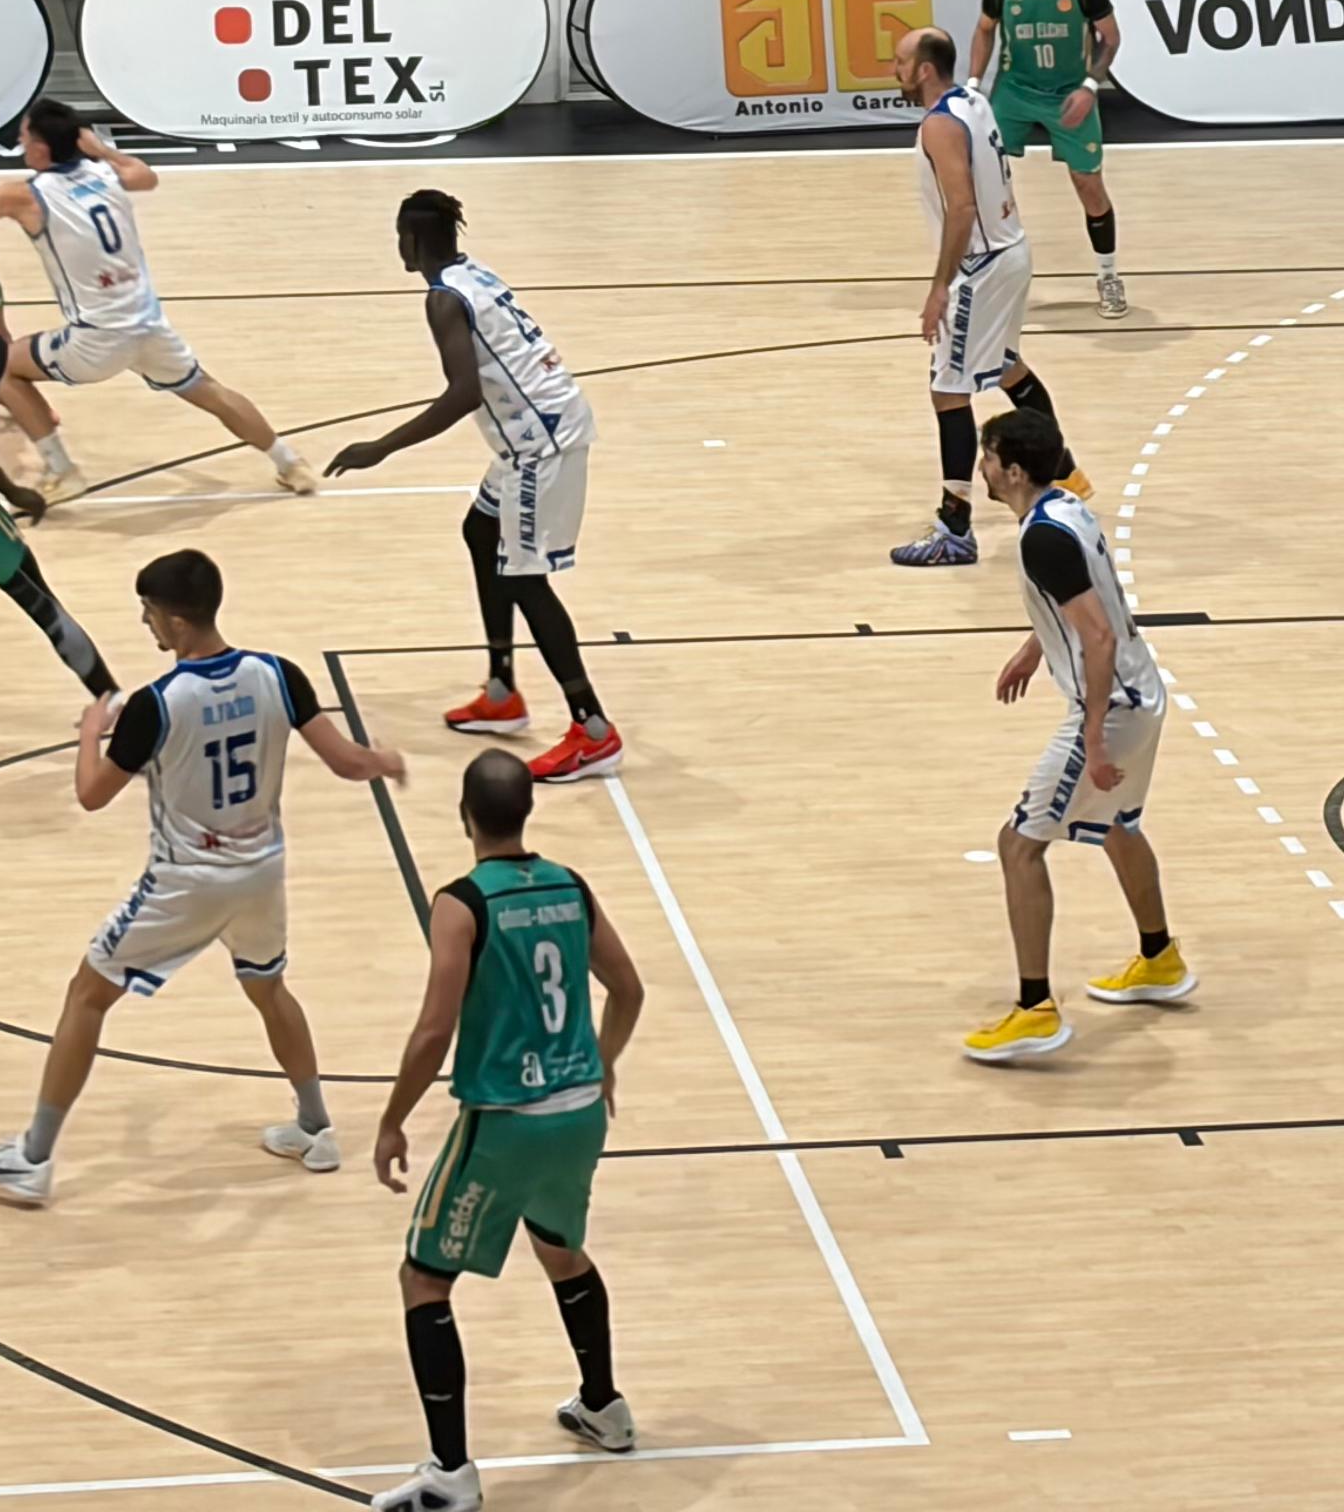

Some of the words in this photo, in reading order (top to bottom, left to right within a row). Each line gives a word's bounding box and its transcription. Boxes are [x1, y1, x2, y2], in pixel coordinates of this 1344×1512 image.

[1033, 44, 1055, 69] 10
[293, 56, 429, 106] TEX
[429, 80, 445, 102] SL
[200, 113, 268, 127] Maquinaria
[270, 111, 300, 125] textil
[302, 114, 309, 125] y
[311, 110, 393, 123] autoconsumo
[395, 108, 423, 120] solar
[735, 97, 824, 117] Antonio
[88, 203, 122, 254] 0
[204, 731, 257, 809] 15
[533, 940, 567, 1035] 3
